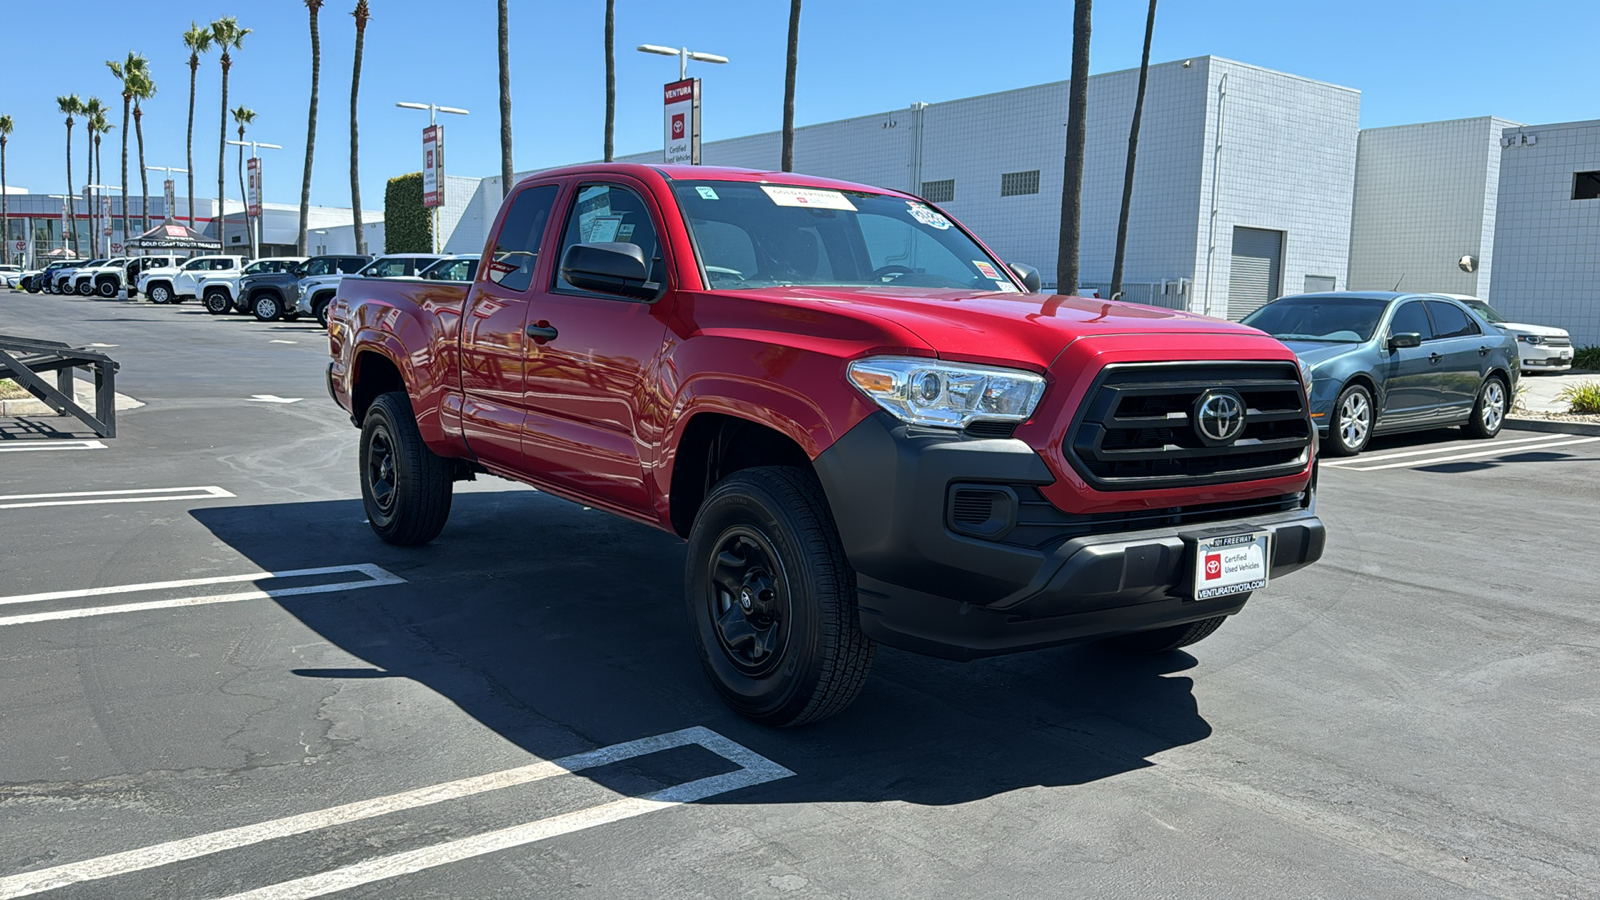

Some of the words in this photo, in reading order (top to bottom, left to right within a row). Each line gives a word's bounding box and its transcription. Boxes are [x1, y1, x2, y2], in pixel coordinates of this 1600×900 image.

[665, 85, 692, 99] VENTURA
[669, 144, 687, 154] Certified
[675, 154, 691, 162] Vehicles
[1223, 535, 1252, 546] FREEWAY
[1224, 553, 1247, 563] Certified
[1224, 565, 1238, 574] Used
[1239, 562, 1260, 571] Vehicles
[1199, 581, 1265, 598] VENTURATOYOTA.COM
